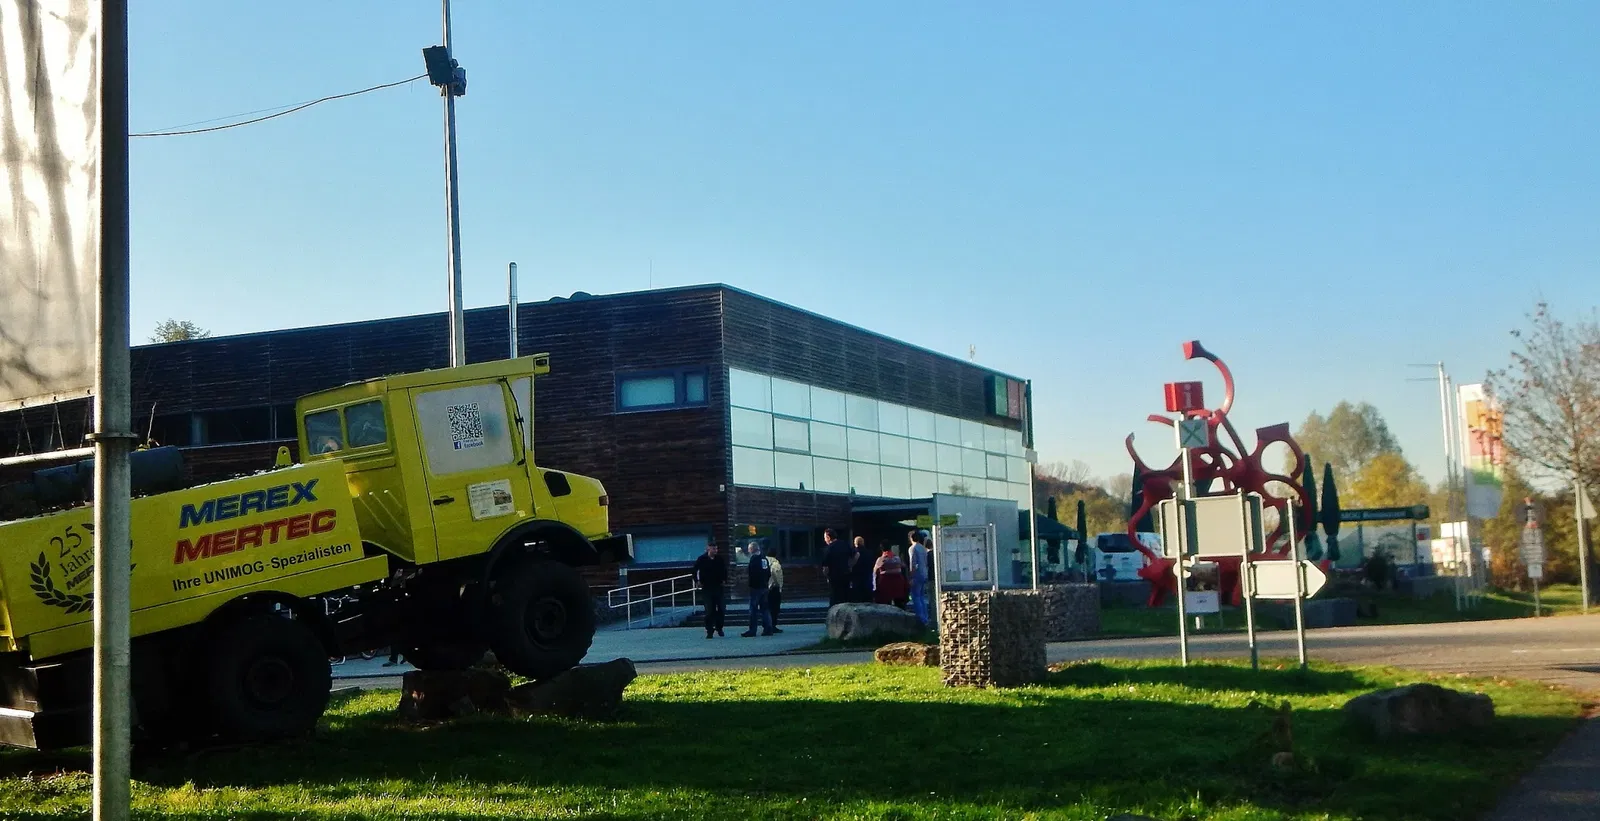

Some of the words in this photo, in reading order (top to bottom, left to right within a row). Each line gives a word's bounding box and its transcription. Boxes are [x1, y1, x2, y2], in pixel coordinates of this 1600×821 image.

[178, 479, 320, 529] MEREX
[50, 525, 82, 558] 25
[173, 509, 337, 564] MERTEC
[172, 577, 201, 592] Ihre
